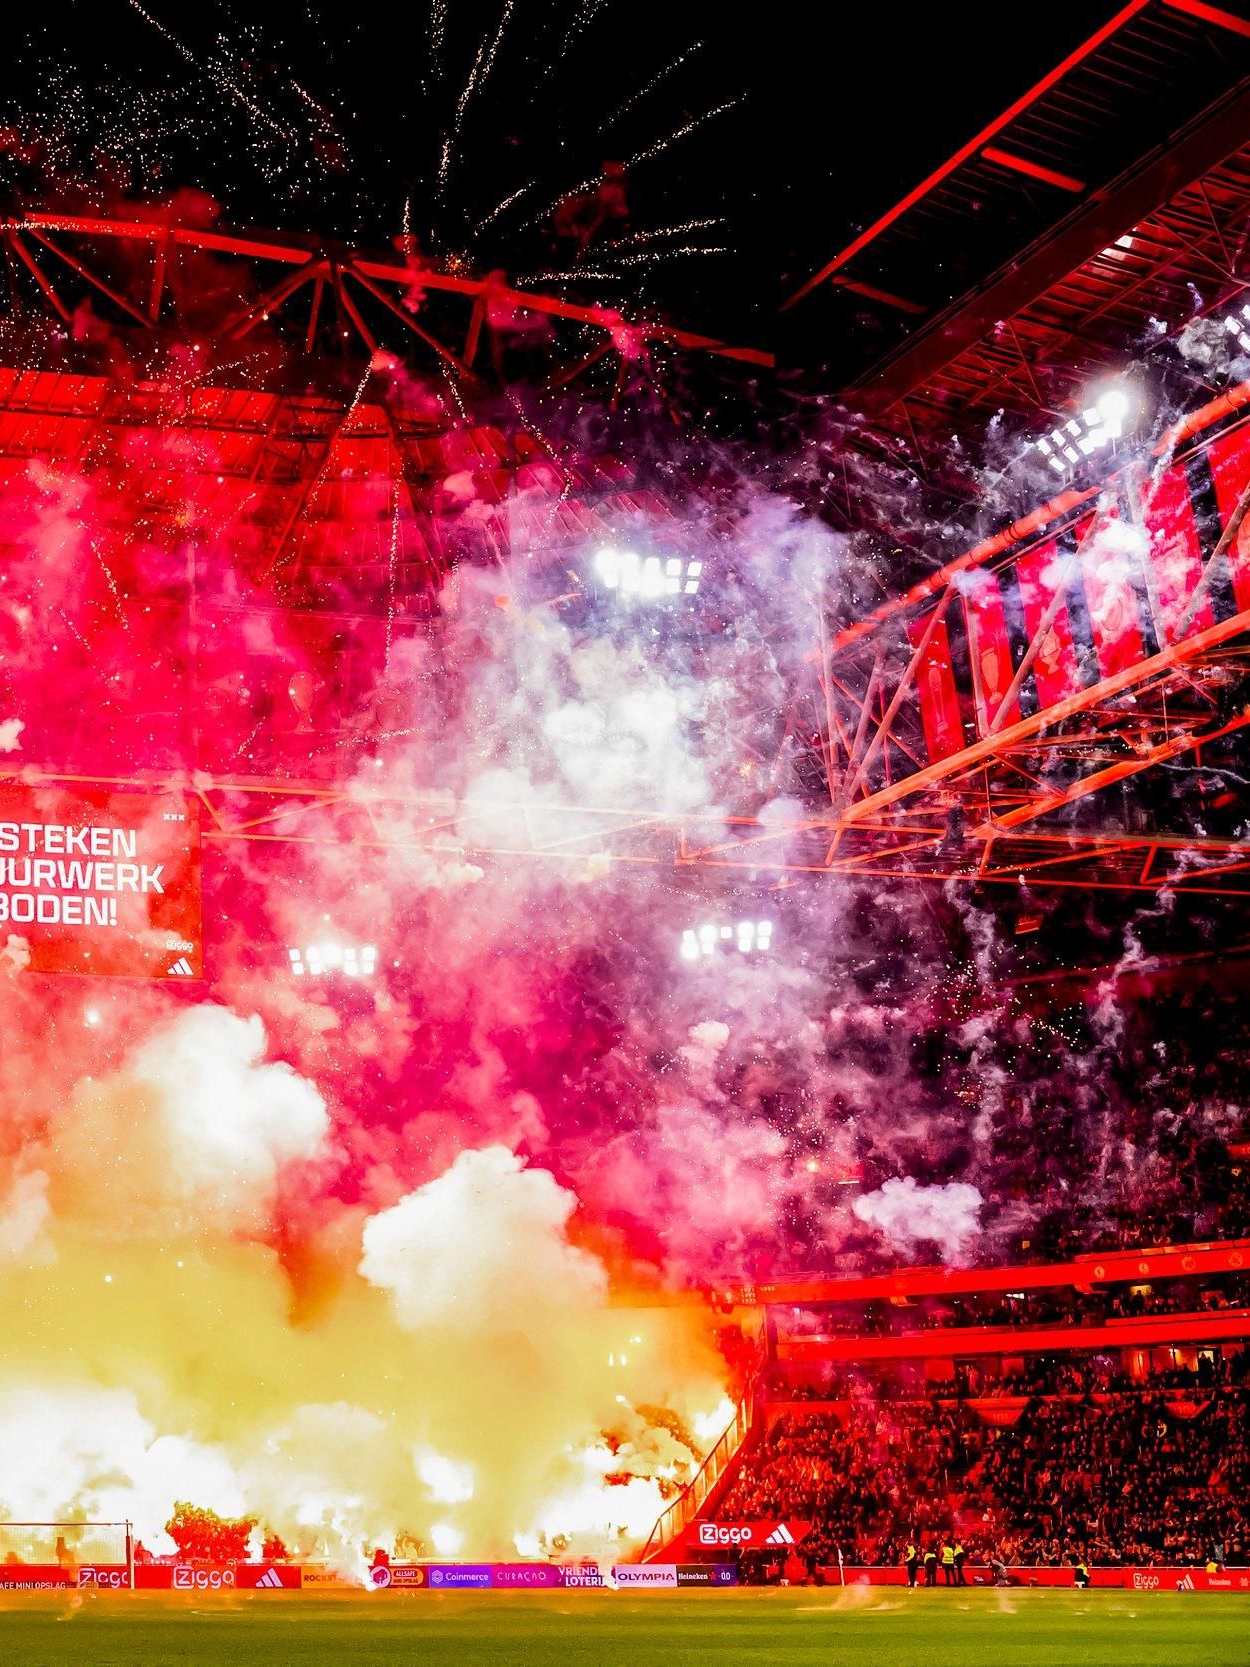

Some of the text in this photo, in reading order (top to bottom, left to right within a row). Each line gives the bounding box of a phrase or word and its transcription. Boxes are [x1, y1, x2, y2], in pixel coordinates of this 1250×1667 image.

[558, 1566, 599, 1576] VRIEND
[445, 1572, 489, 1581] Coinmerce
[617, 1573, 675, 1581] OLYMPIA
[678, 1572, 709, 1580] Heineken
[35, 1582, 66, 1590] OPSLAG
